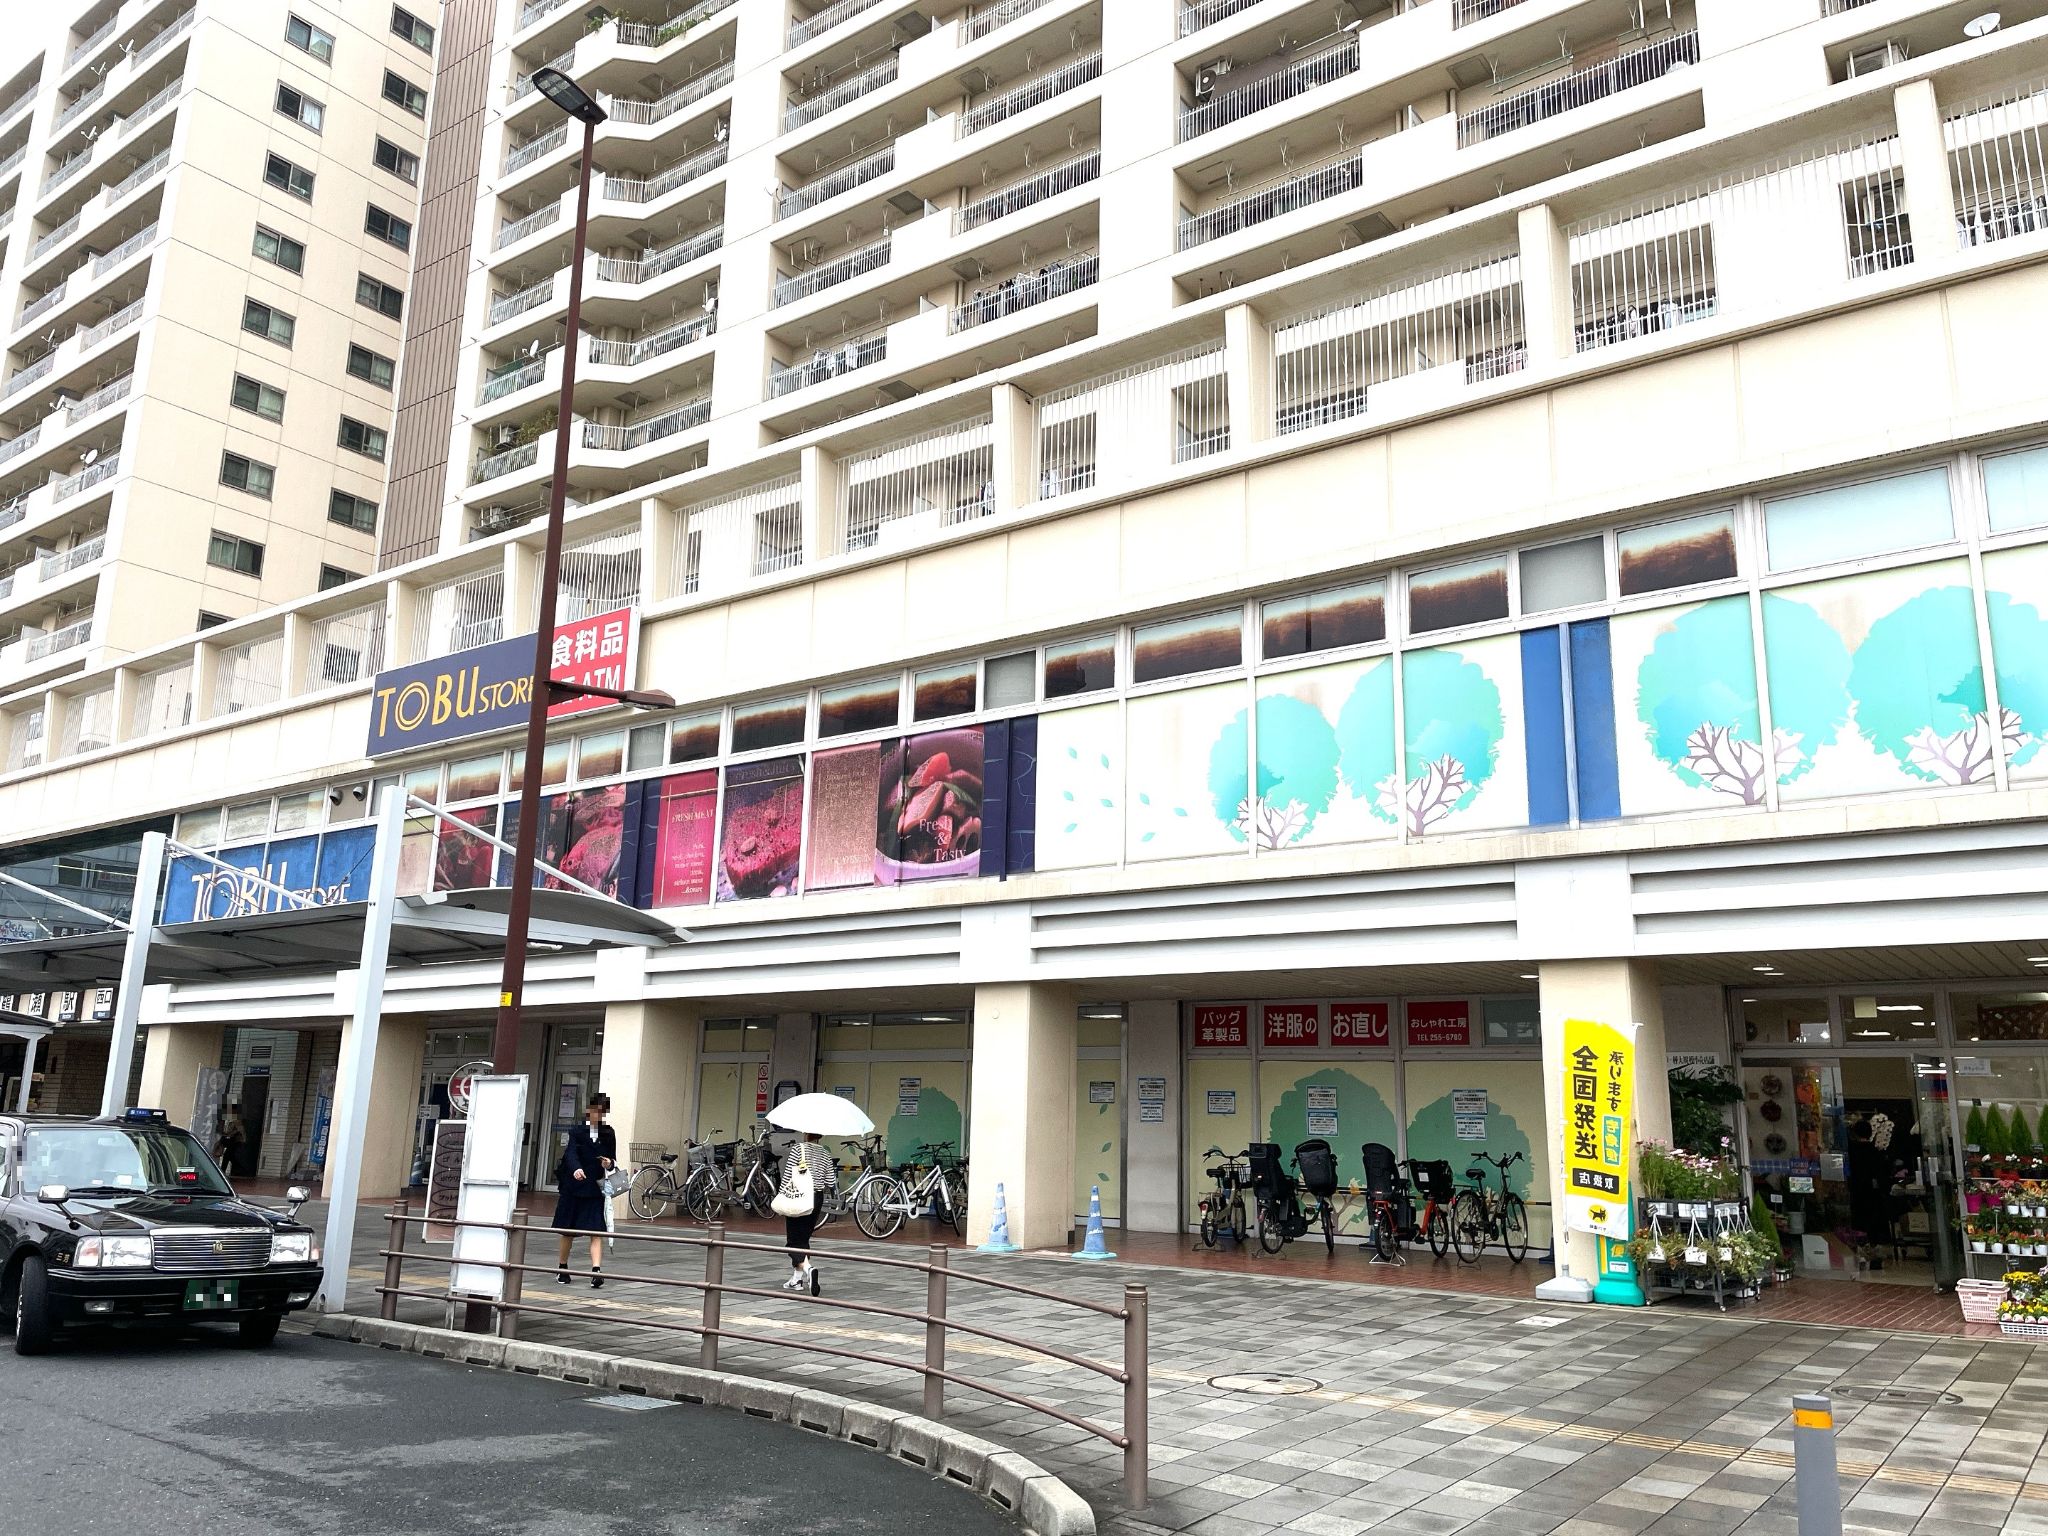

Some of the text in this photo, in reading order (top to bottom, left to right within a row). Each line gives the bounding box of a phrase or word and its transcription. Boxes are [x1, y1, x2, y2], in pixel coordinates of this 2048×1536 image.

[551, 620, 625, 670] 食料品
[578, 664, 621, 701] ATM
[376, 666, 480, 738] TOBU
[919, 818, 953, 832] Fresh
[934, 832, 945, 845] &
[933, 848, 966, 862] Tasty
[191, 862, 288, 922] TOBU
[1201, 1010, 1241, 1026] バッグ
[1267, 1012, 1389, 1039] 洋服の お直し
[1410, 1017, 1467, 1029] おしゃれ工房
[1201, 1027, 1241, 1042] 革製品
[1416, 1034, 1428, 1042] TEL
